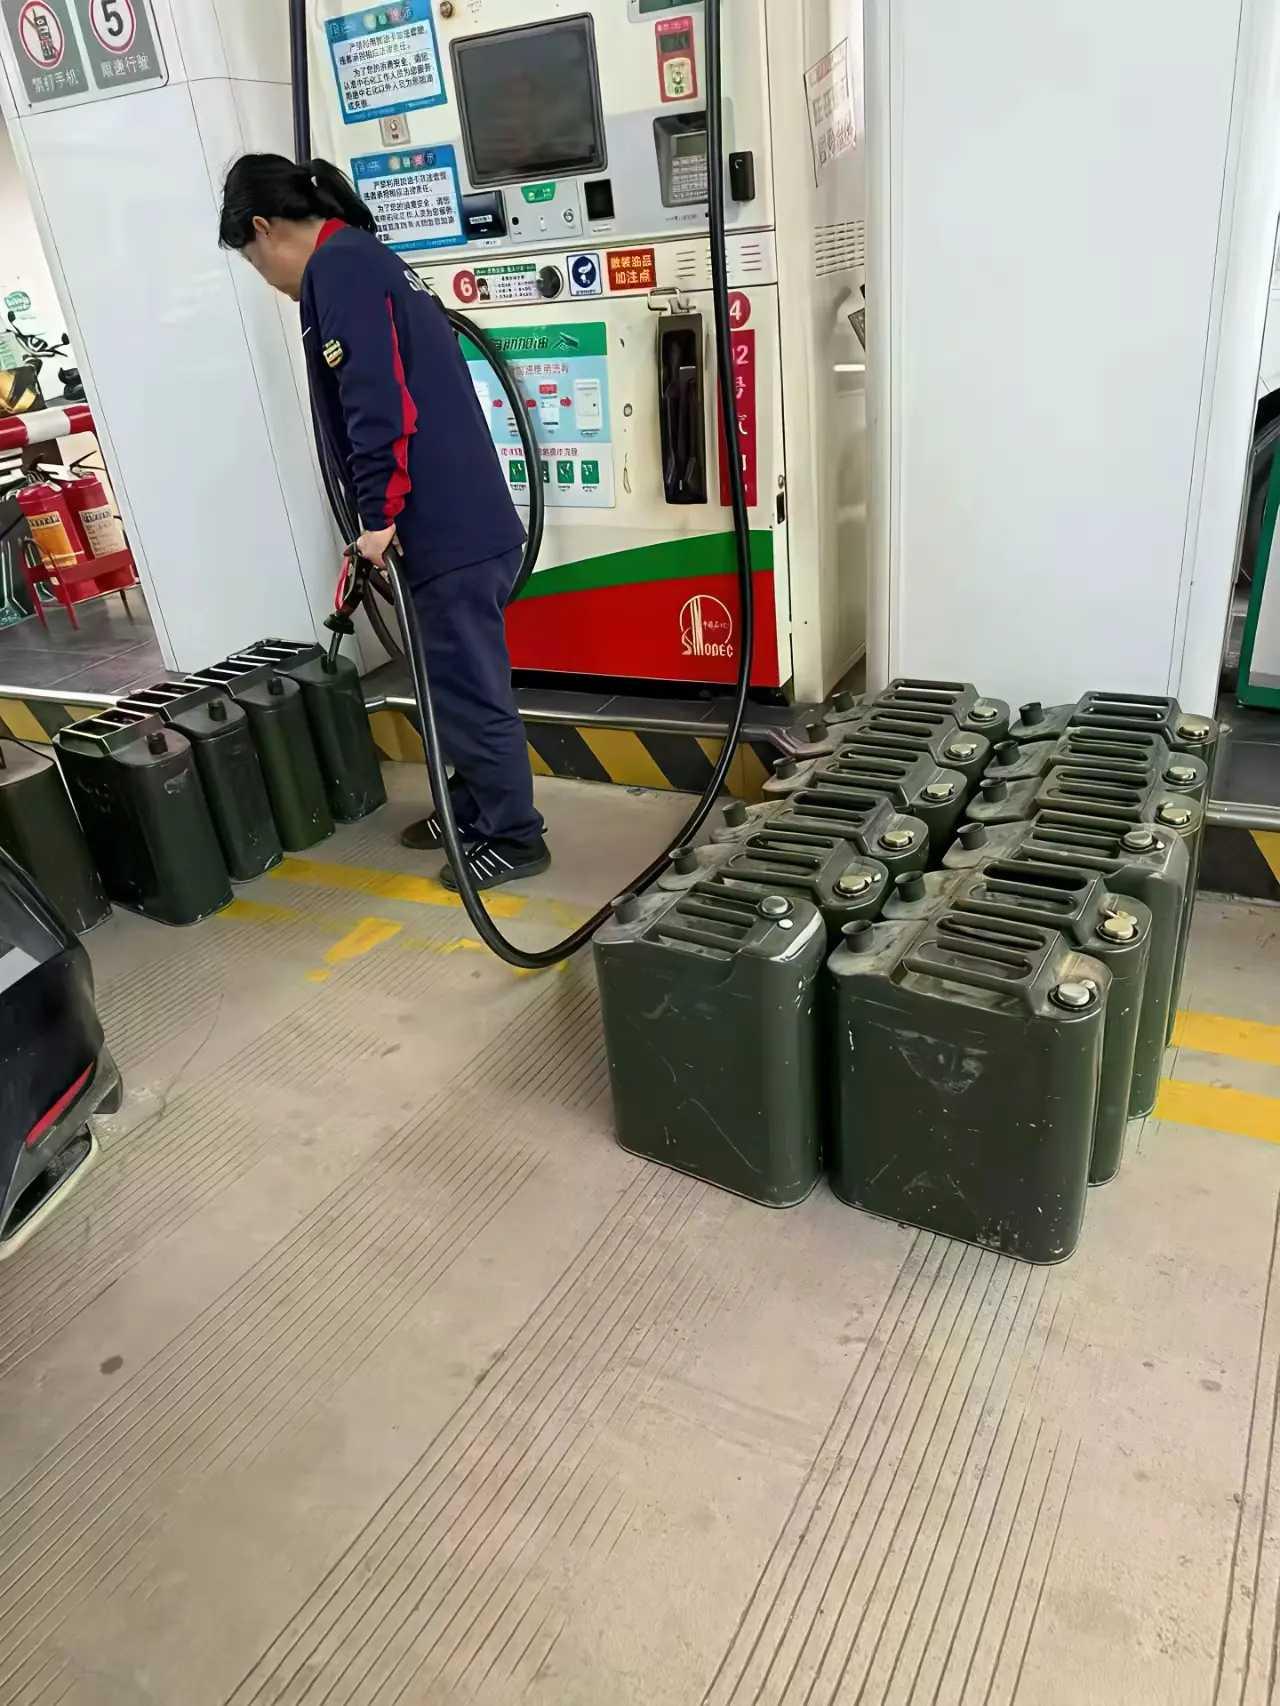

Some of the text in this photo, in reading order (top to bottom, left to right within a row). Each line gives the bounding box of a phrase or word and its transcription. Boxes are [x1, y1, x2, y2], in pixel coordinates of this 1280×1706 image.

[101, 0, 123, 36] 5
[100, 53, 151, 78] 限速行驶
[610, 254, 653, 269] 散装油品
[615, 270, 650, 284] 加注点
[460, 279, 474, 298] 6
[729, 300, 742, 320] 4
